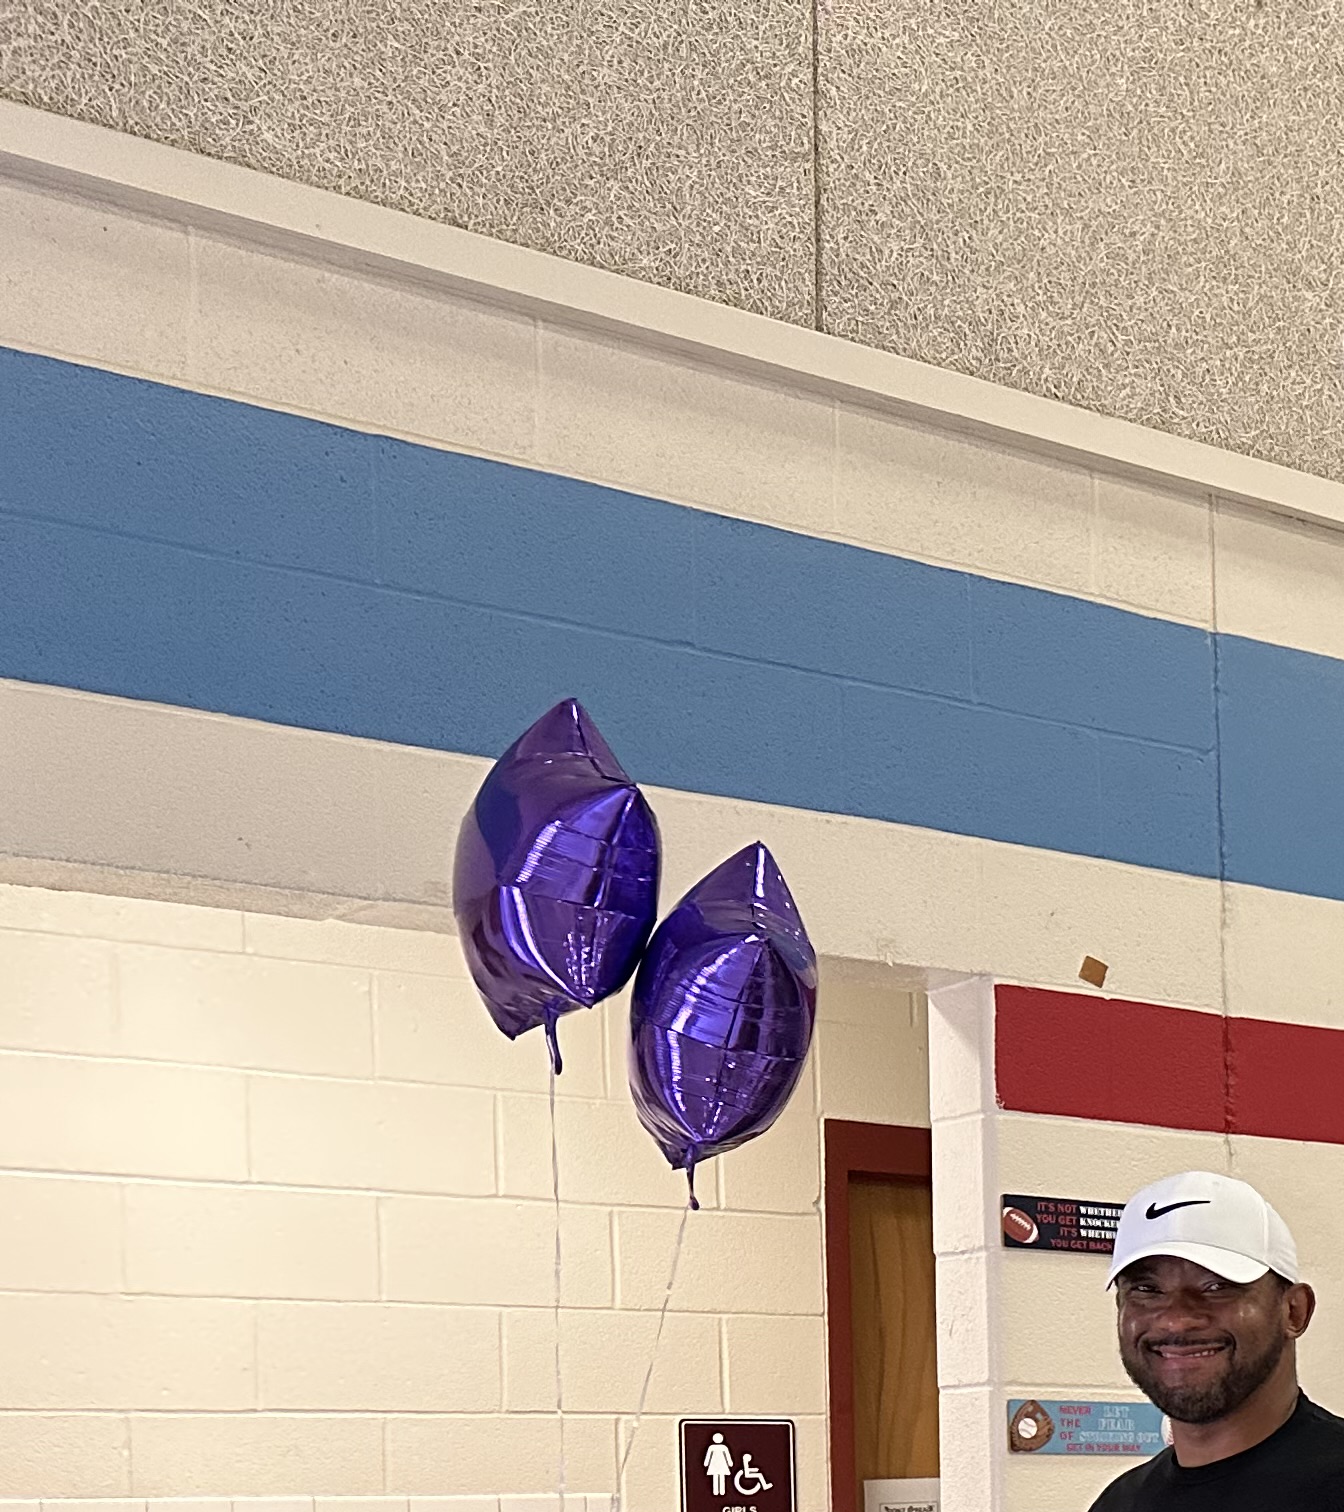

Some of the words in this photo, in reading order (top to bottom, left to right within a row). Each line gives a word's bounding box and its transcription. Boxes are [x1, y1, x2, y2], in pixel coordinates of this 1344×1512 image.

[1057, 1203, 1077, 1214] NOT
[1036, 1214, 1056, 1223] YOU
[1058, 1216, 1077, 1225] GET
[1050, 1239, 1069, 1248] YOU
[1070, 1240, 1088, 1250] GET
[1060, 1418, 1081, 1428] THE
